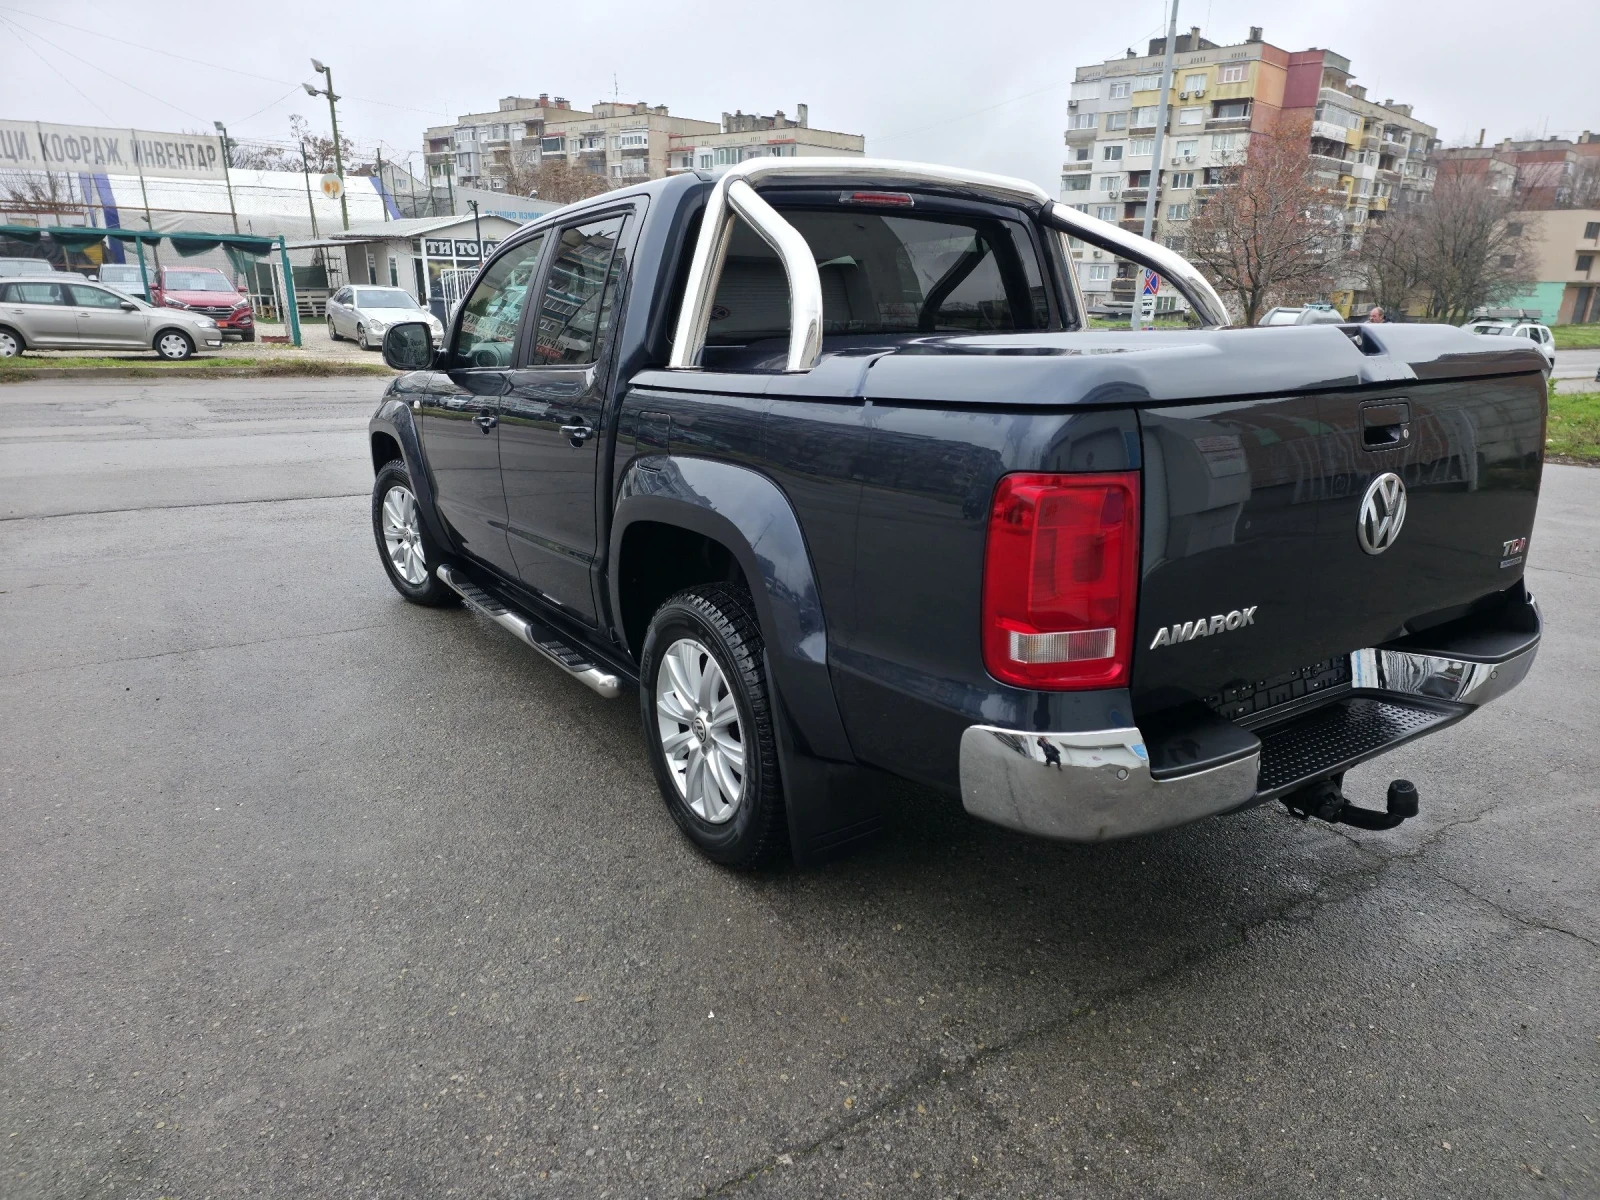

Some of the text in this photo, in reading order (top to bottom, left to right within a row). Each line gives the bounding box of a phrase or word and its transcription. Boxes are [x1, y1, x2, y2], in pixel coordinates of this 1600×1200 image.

[0, 130, 216, 171] ЦИ, КОФРАЖ, ИНВЕНТАР
[1502, 537, 1526, 557] TDI
[1150, 605, 1258, 650] AMAROK
